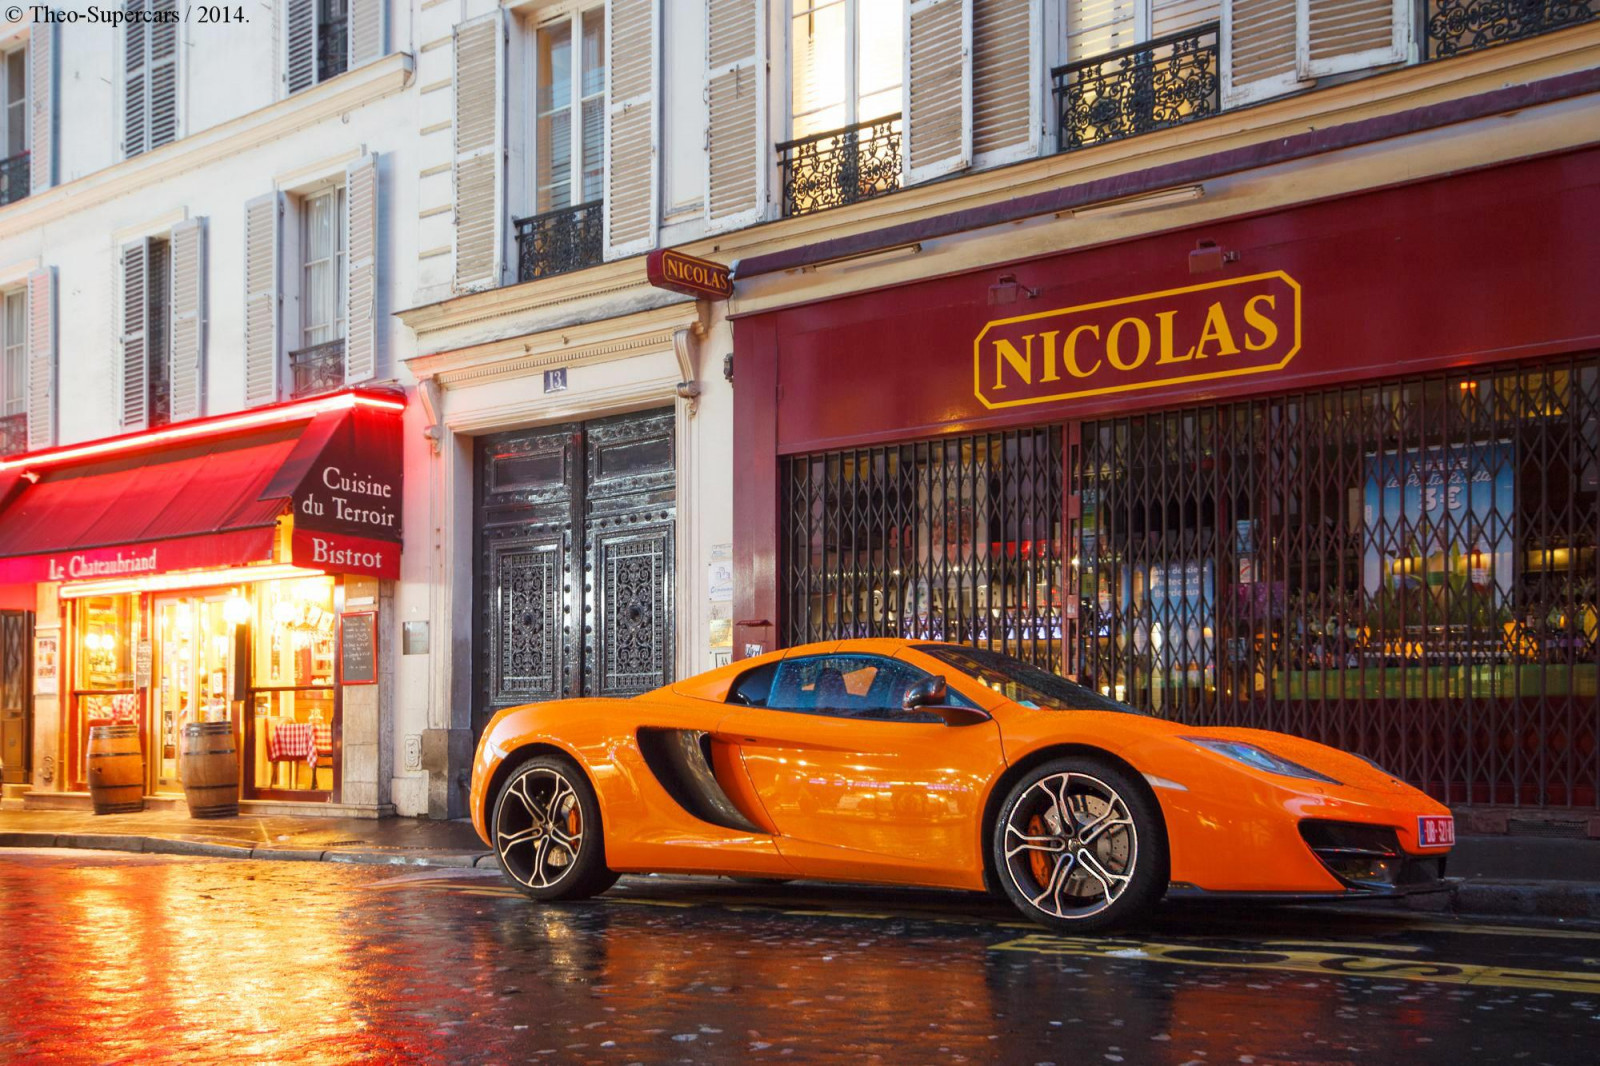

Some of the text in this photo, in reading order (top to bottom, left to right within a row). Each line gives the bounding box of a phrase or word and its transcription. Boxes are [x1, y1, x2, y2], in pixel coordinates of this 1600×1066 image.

[668, 259, 728, 290] NICOLAS
[991, 293, 1279, 390] NICOLAS
[549, 370, 562, 389] 13
[322, 466, 392, 498] Cuisine
[301, 493, 395, 526] du Terroir
[49, 548, 157, 580] Le Chateaubriand
[311, 537, 382, 568] Bistrot
